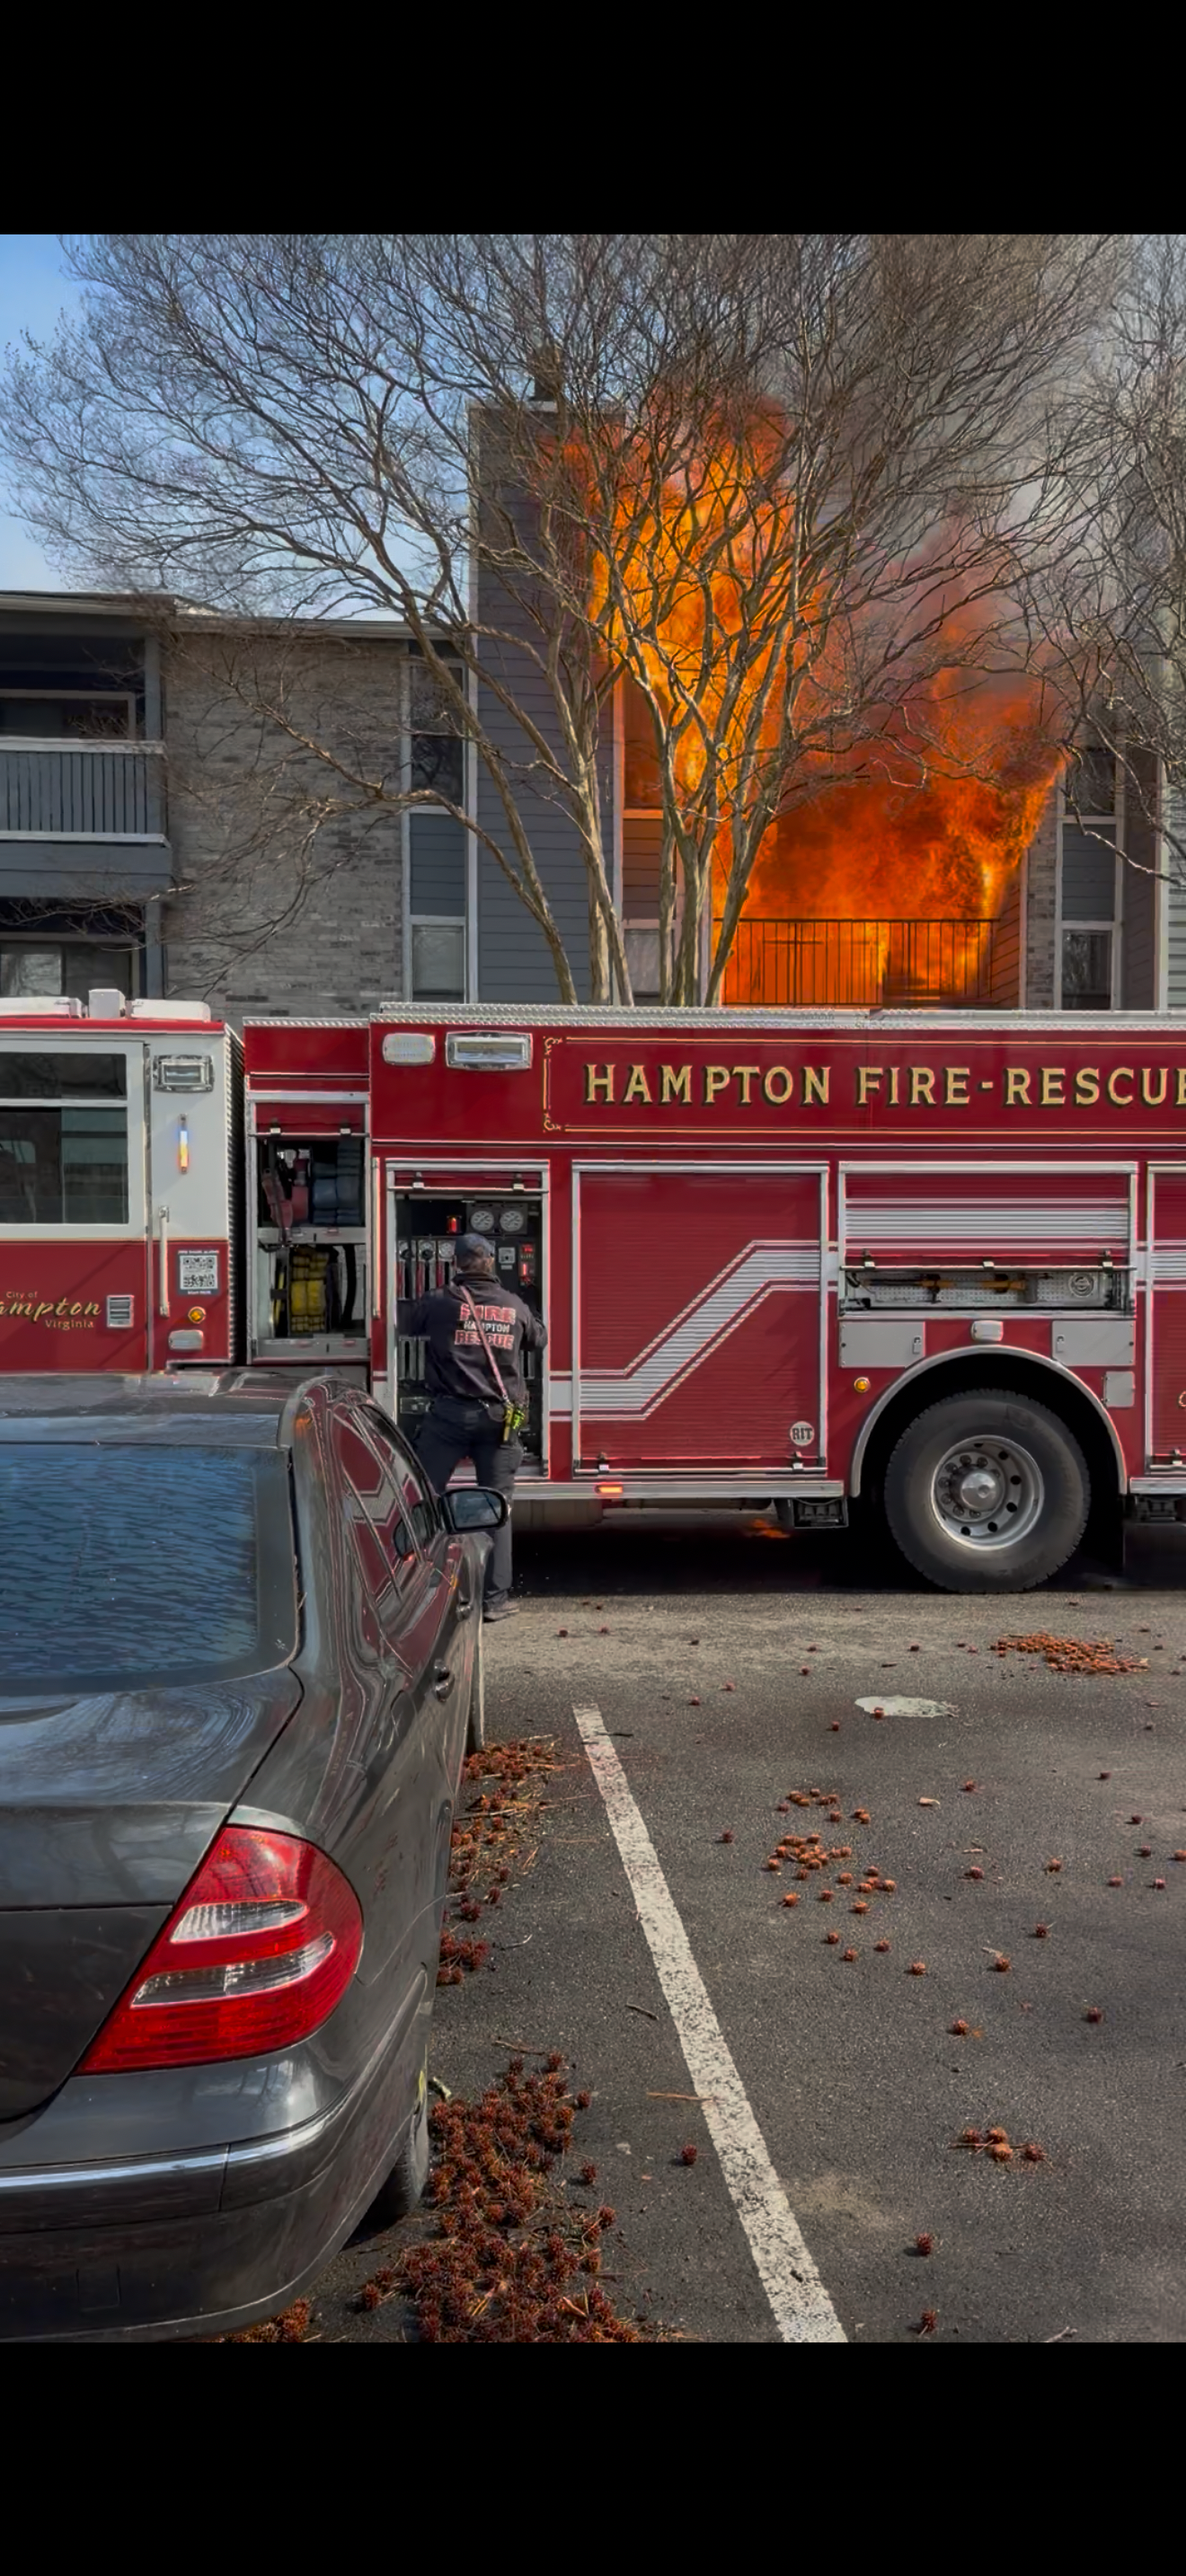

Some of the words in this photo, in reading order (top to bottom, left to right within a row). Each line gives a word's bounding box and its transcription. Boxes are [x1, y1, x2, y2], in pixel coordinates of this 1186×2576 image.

[585, 1063, 831, 1105] HAMPTON
[5, 1291, 25, 1301] City
[28, 1291, 38, 1299] of
[460, 1303, 516, 1325] FIRE
[45, 1319, 94, 1331] Virginia
[792, 1427, 812, 1441] RIT
